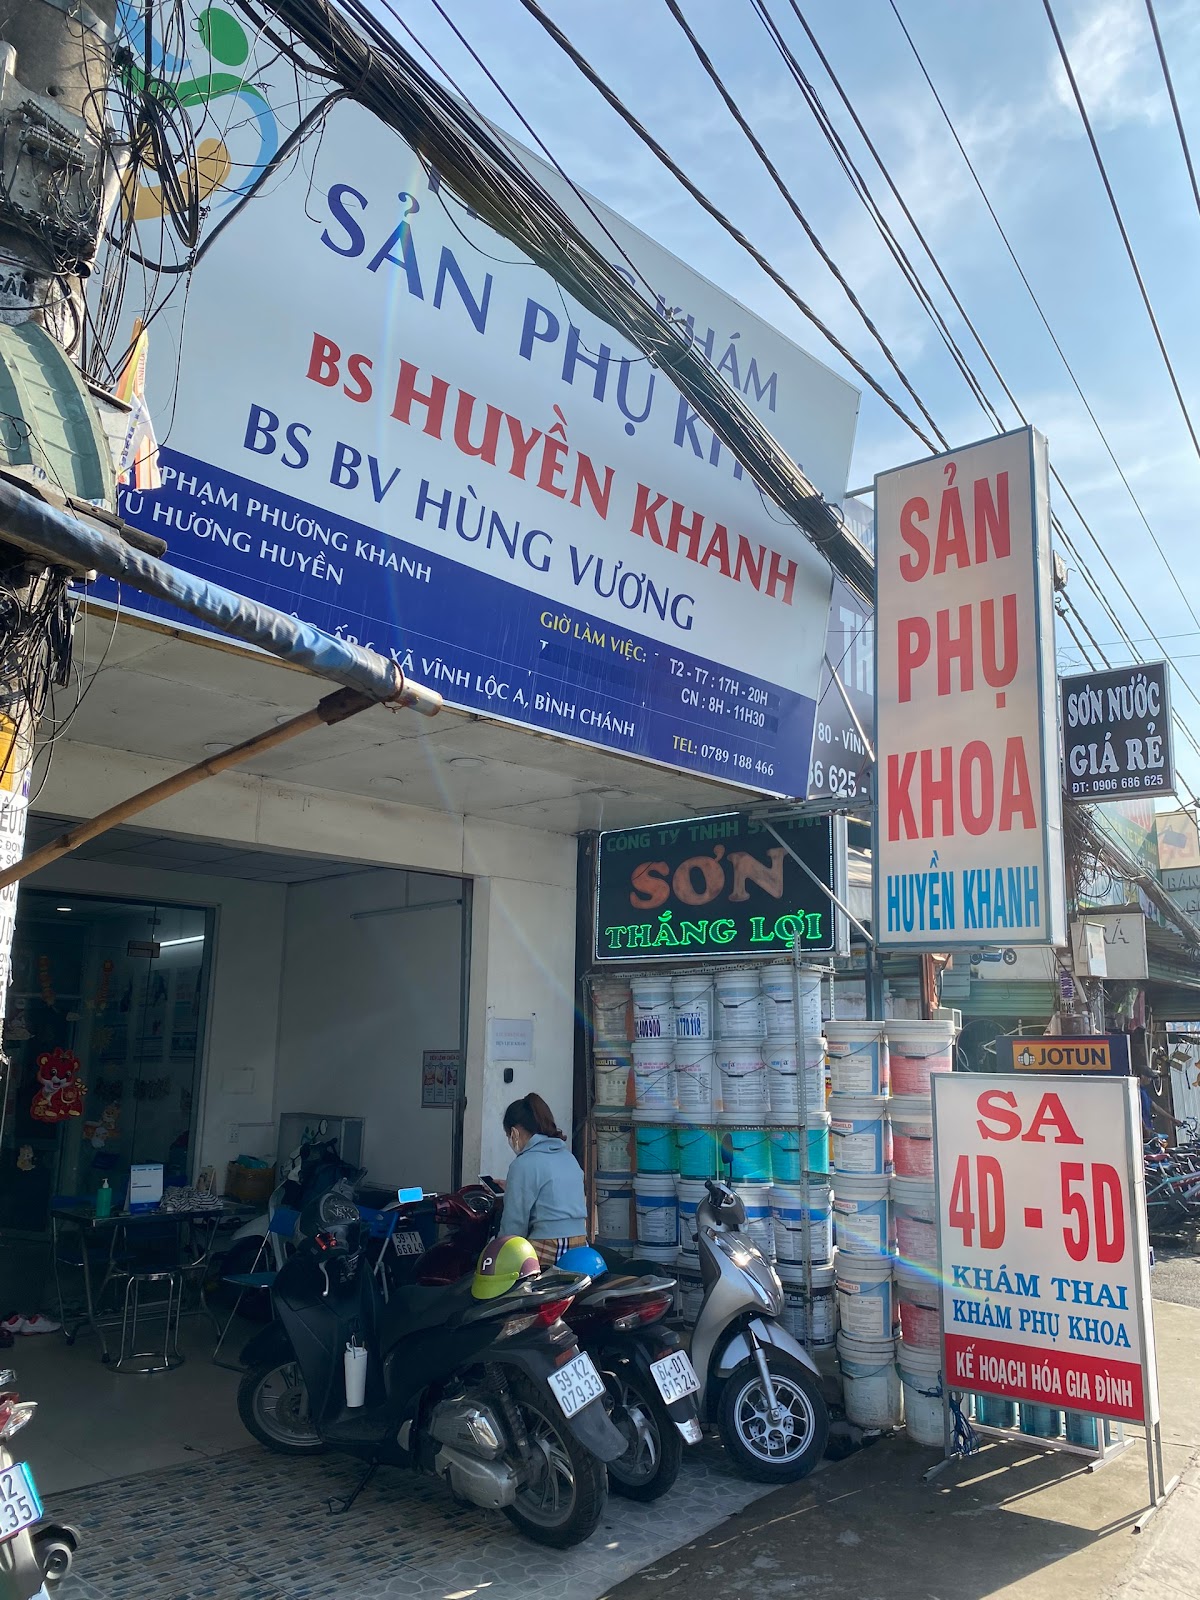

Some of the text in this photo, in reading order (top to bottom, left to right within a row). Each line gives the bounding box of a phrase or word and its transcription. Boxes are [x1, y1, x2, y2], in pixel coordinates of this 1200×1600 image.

[320, 183, 493, 335] SẢN
[519, 297, 656, 436] PHỤ
[306, 331, 373, 403] BS
[390, 358, 616, 521] HUYỀN
[630, 482, 798, 606] KHANH
[152, 502, 251, 553] HƯƠNG
[259, 540, 344, 586] HUYỀN
[160, 465, 431, 583] PHẠM PHƯƠNG KHANH
[243, 403, 695, 631] BS BV HÙNG VƯƠNG
[899, 462, 1011, 583] SẢN
[540, 611, 571, 634] GIỜ
[574, 622, 605, 648] LÀM
[610, 636, 647, 662] VIỆC:
[897, 594, 1018, 709] PHỤ
[390, 648, 414, 672] XÃ
[421, 657, 470, 689] VĨNH
[475, 674, 509, 702] LỘC
[513, 688, 530, 709] A,
[535, 692, 575, 720] BÌNH
[580, 708, 635, 737] CHÁNH
[670, 658, 684, 678] T2
[695, 667, 708, 686] T7
[718, 676, 738, 696] 17H
[748, 689, 768, 706] 20H
[681, 688, 699, 707] CN
[708, 697, 723, 715] 8H
[734, 703, 765, 728] 11H30
[1068, 673, 1160, 727] SƠN NƯỚC
[673, 735, 774, 776] TEL: 0789 188 466
[1069, 721, 1164, 776] GIÁ RẺ
[887, 736, 1037, 842] KHOA
[1072, 774, 1163, 793] ĐT: 0906 686 625
[606, 829, 650, 852] CÔNG
[658, 828, 681, 845] TY
[688, 820, 739, 842] TNHH
[629, 844, 788, 910] SƠN
[887, 850, 1040, 932] HUYỀN KHANH
[604, 909, 822, 949] THẮNG LỢI
[1038, 1047, 1106, 1066] JOTUN
[976, 1089, 1084, 1145] SA
[949, 1154, 1006, 1249] 4D
[1060, 1161, 1125, 1263] 5D
[951, 1264, 1129, 1310] KHÁM THAI
[953, 1297, 1131, 1348] KHÁM PHỤ KHOA
[555, 1359, 589, 1391] 59-K2
[562, 1375, 601, 1413] 079.33
[956, 1343, 1133, 1408] KẾ HOẠCH HÓA GIA ĐÌNH
